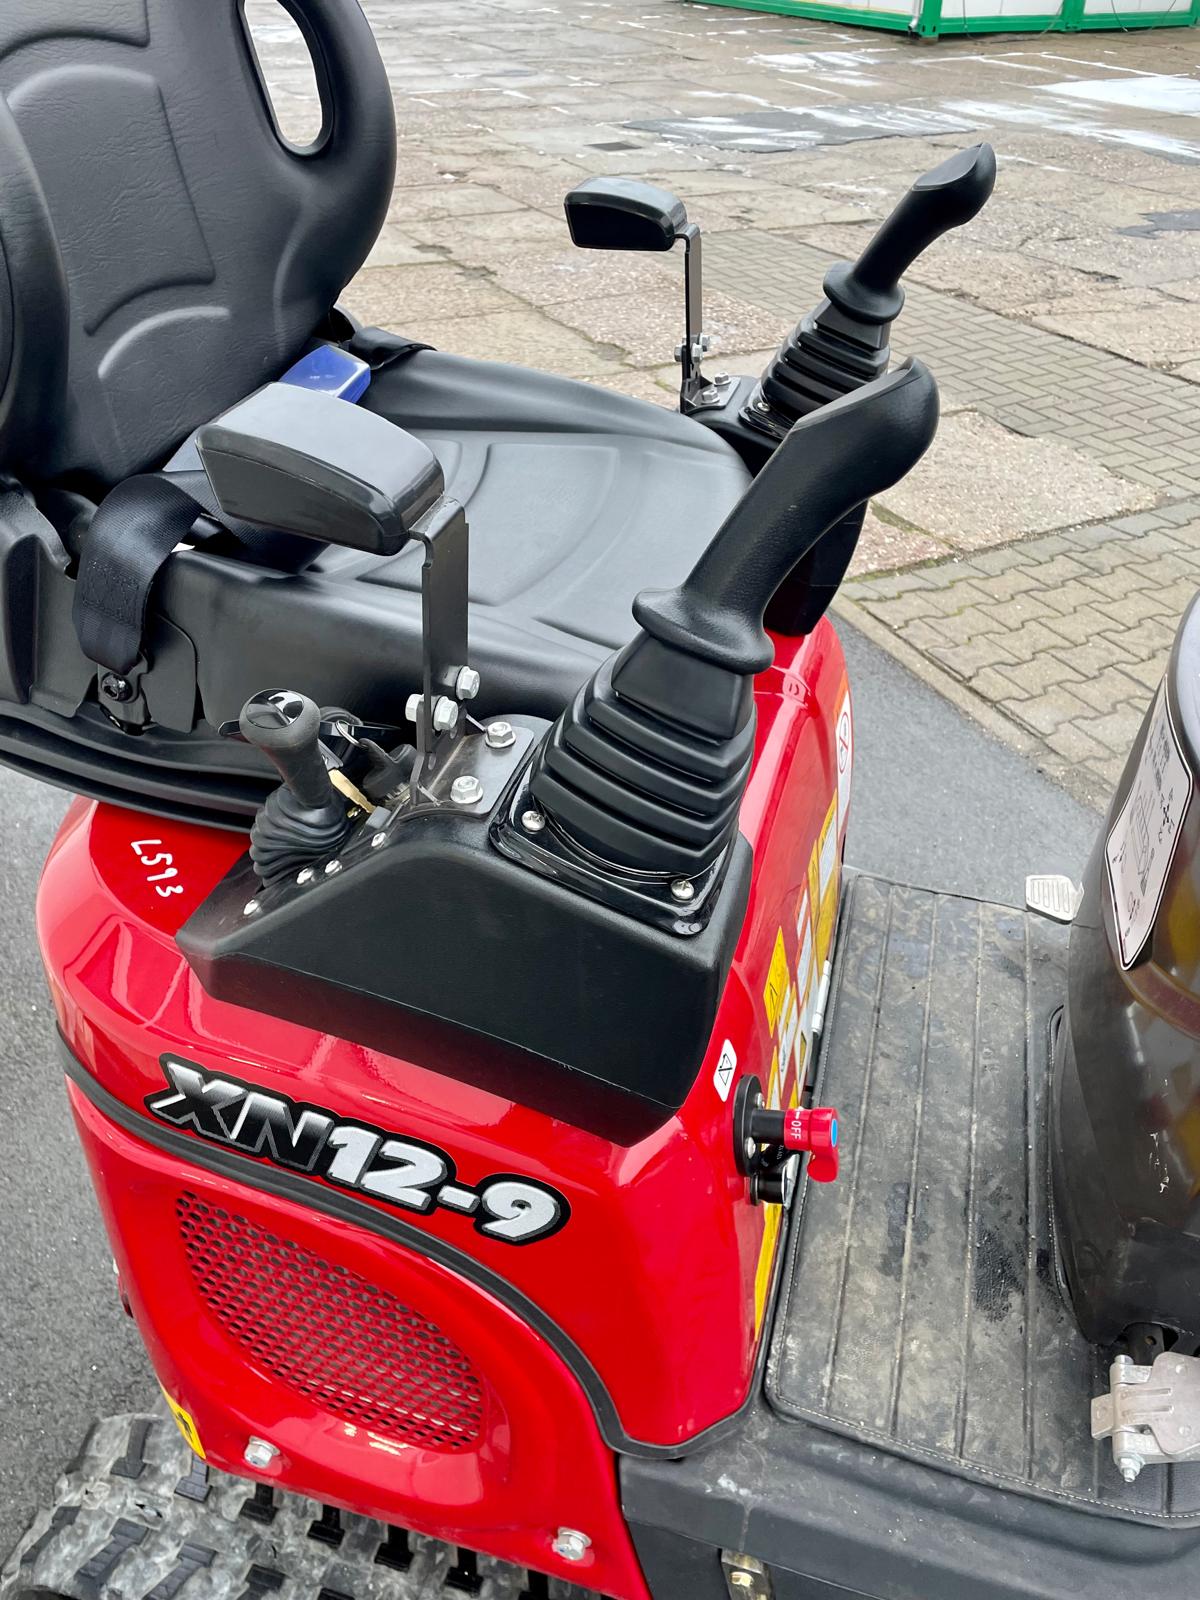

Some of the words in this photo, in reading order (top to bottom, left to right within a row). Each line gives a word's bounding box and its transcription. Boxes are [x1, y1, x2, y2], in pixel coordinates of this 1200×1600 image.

[131, 839, 184, 897] L593
[150, 1061, 561, 1241] XN12-9
[790, 1120, 802, 1140] OFF
